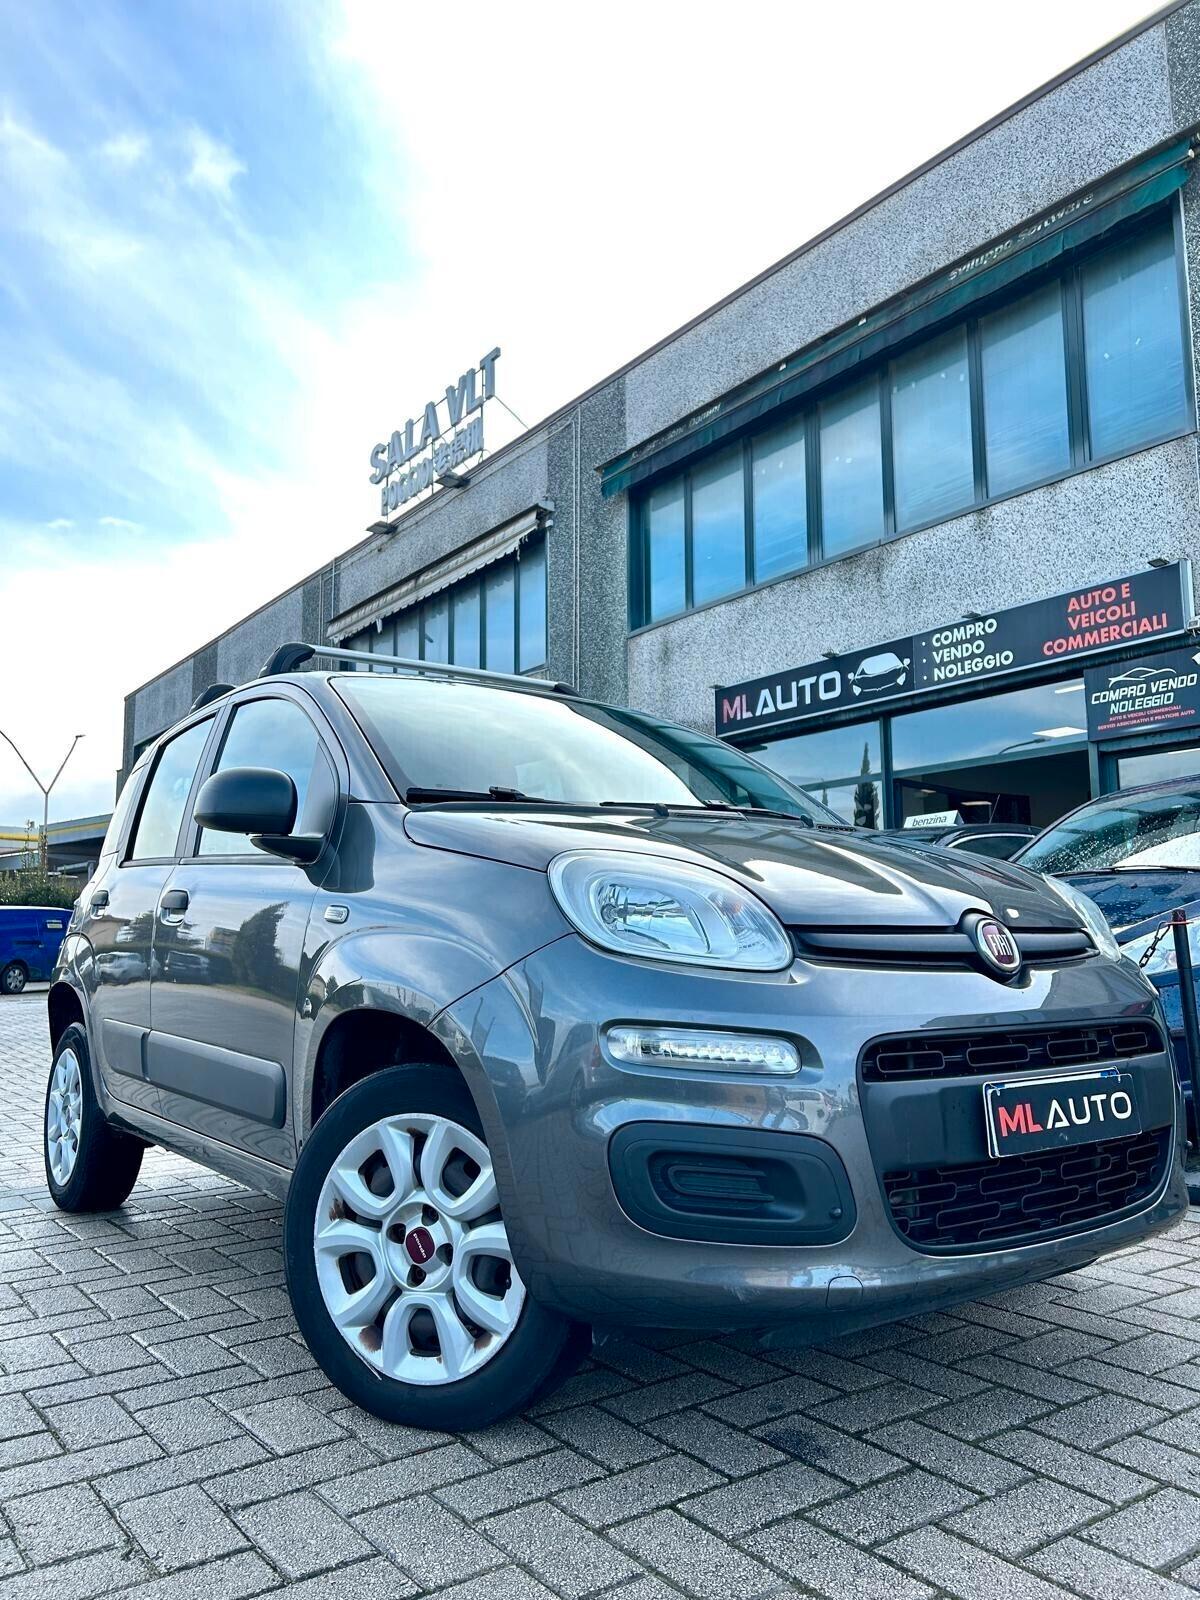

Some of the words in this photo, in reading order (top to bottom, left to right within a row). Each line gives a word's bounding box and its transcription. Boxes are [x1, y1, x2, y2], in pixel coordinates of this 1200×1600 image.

[369, 401, 441, 485] SALA
[445, 346, 502, 428] VLT
[1067, 586, 1117, 613] AUTO
[1121, 582, 1131, 599] E
[1068, 601, 1136, 631] VEICOLI
[932, 618, 998, 648] COMPRO
[1043, 612, 1168, 657] COMMERCIALI
[932, 639, 985, 665] VENDO
[933, 650, 1014, 682] NOLEGGIO
[1091, 683, 1147, 705] COMPRO
[1150, 673, 1198, 693] VENDO
[1110, 692, 1174, 715] NOLEGGIO
[1109, 714, 1122, 722] AUTO
[1147, 704, 1181, 715] COMMERCIALI
[1180, 708, 1196, 717] AUTO
[911, 813, 948, 828] benzina
[987, 934, 1013, 956] FIAT
